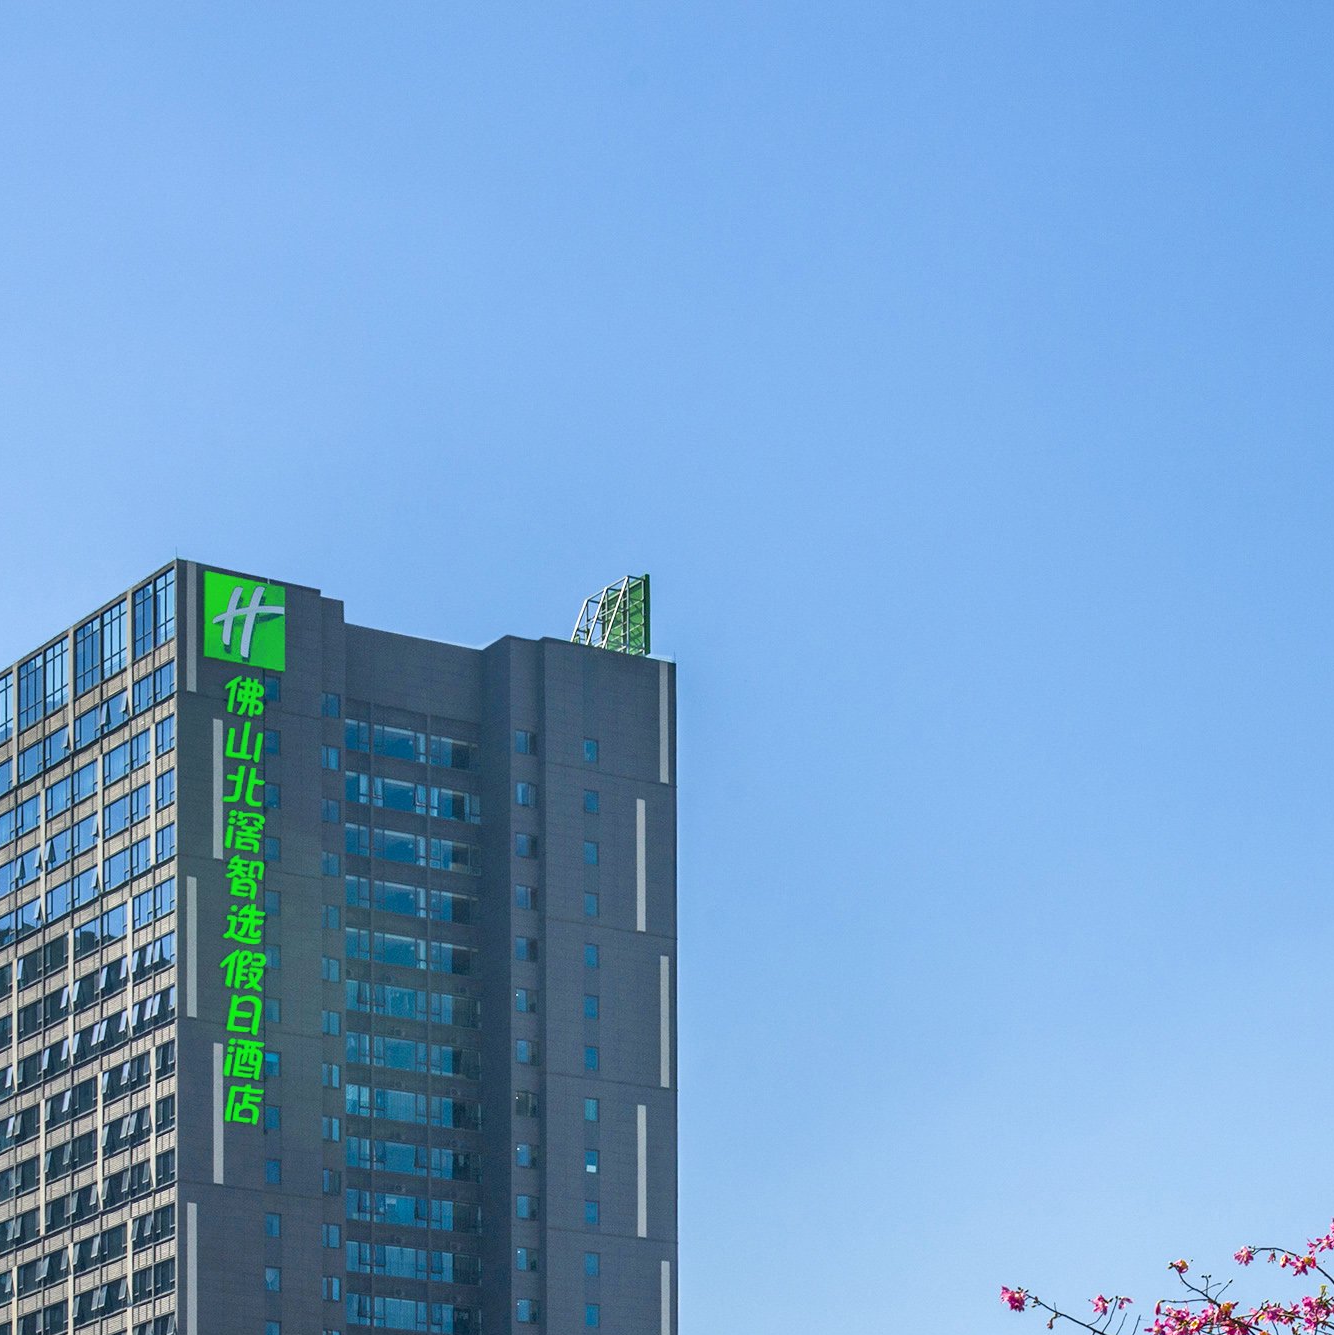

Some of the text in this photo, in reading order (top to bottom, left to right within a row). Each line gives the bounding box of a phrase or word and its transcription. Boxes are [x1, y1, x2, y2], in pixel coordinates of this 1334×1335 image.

[220, 675, 266, 1125] 佛山北滘智选假日酒店
